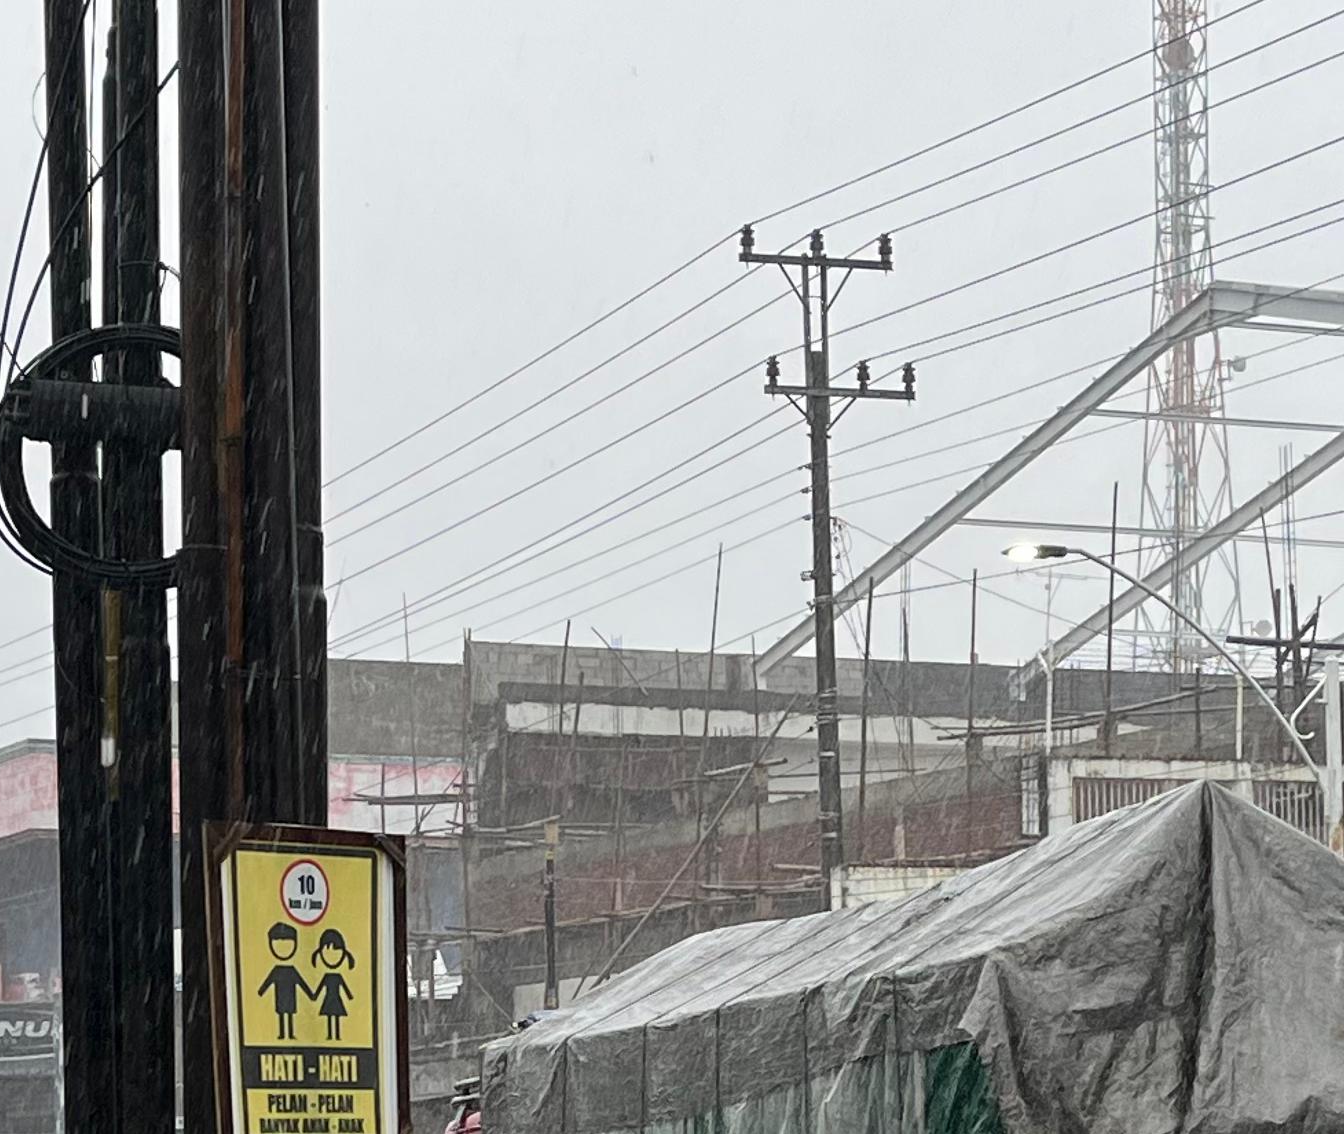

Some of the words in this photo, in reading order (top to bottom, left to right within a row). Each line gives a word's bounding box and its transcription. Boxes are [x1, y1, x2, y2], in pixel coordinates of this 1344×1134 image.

[298, 875, 315, 895] 10
[260, 1054, 304, 1082] HATI
[318, 1055, 358, 1082] HATI
[268, 1093, 307, 1113] PELAN
[318, 1094, 354, 1113] PELAN
[260, 1118, 300, 1134] BANYAK
[302, 1118, 329, 1134] ANAK
[338, 1118, 364, 1134] ANAK
